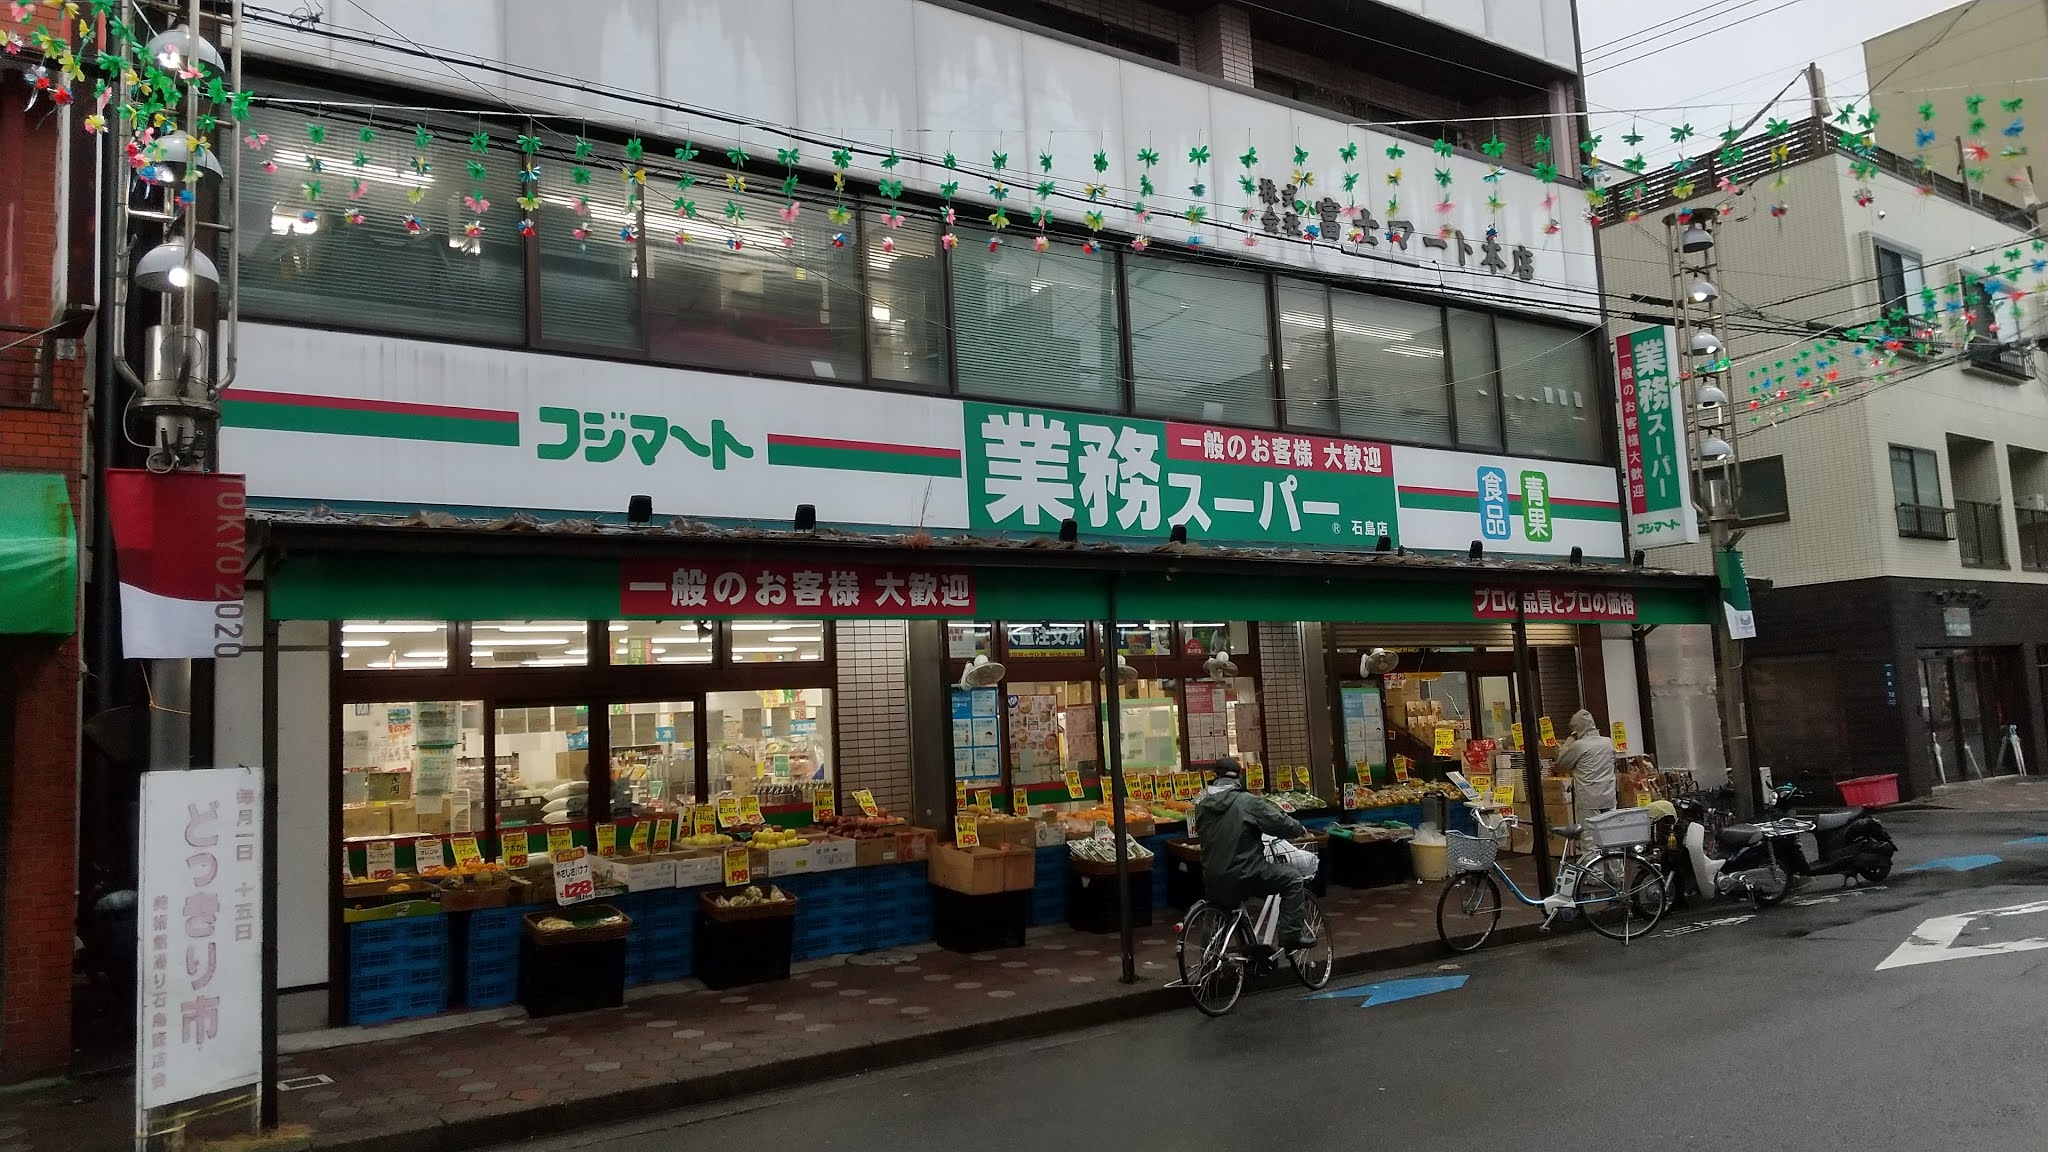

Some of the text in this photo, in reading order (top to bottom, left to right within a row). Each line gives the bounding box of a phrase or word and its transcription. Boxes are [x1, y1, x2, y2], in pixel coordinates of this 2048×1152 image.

[1634, 338, 1671, 498] 業務スーパー
[981, 412, 1340, 532] 業務スーパー
[1180, 430, 1383, 473] 一般のお客様 大歓迎
[1351, 520, 1388, 536] 石島店
[1481, 472, 1507, 536] 食品
[1524, 476, 1549, 538] 青果
[629, 568, 971, 608] 一般のお客様 大歓迎
[213, 584, 245, 659] 2020
